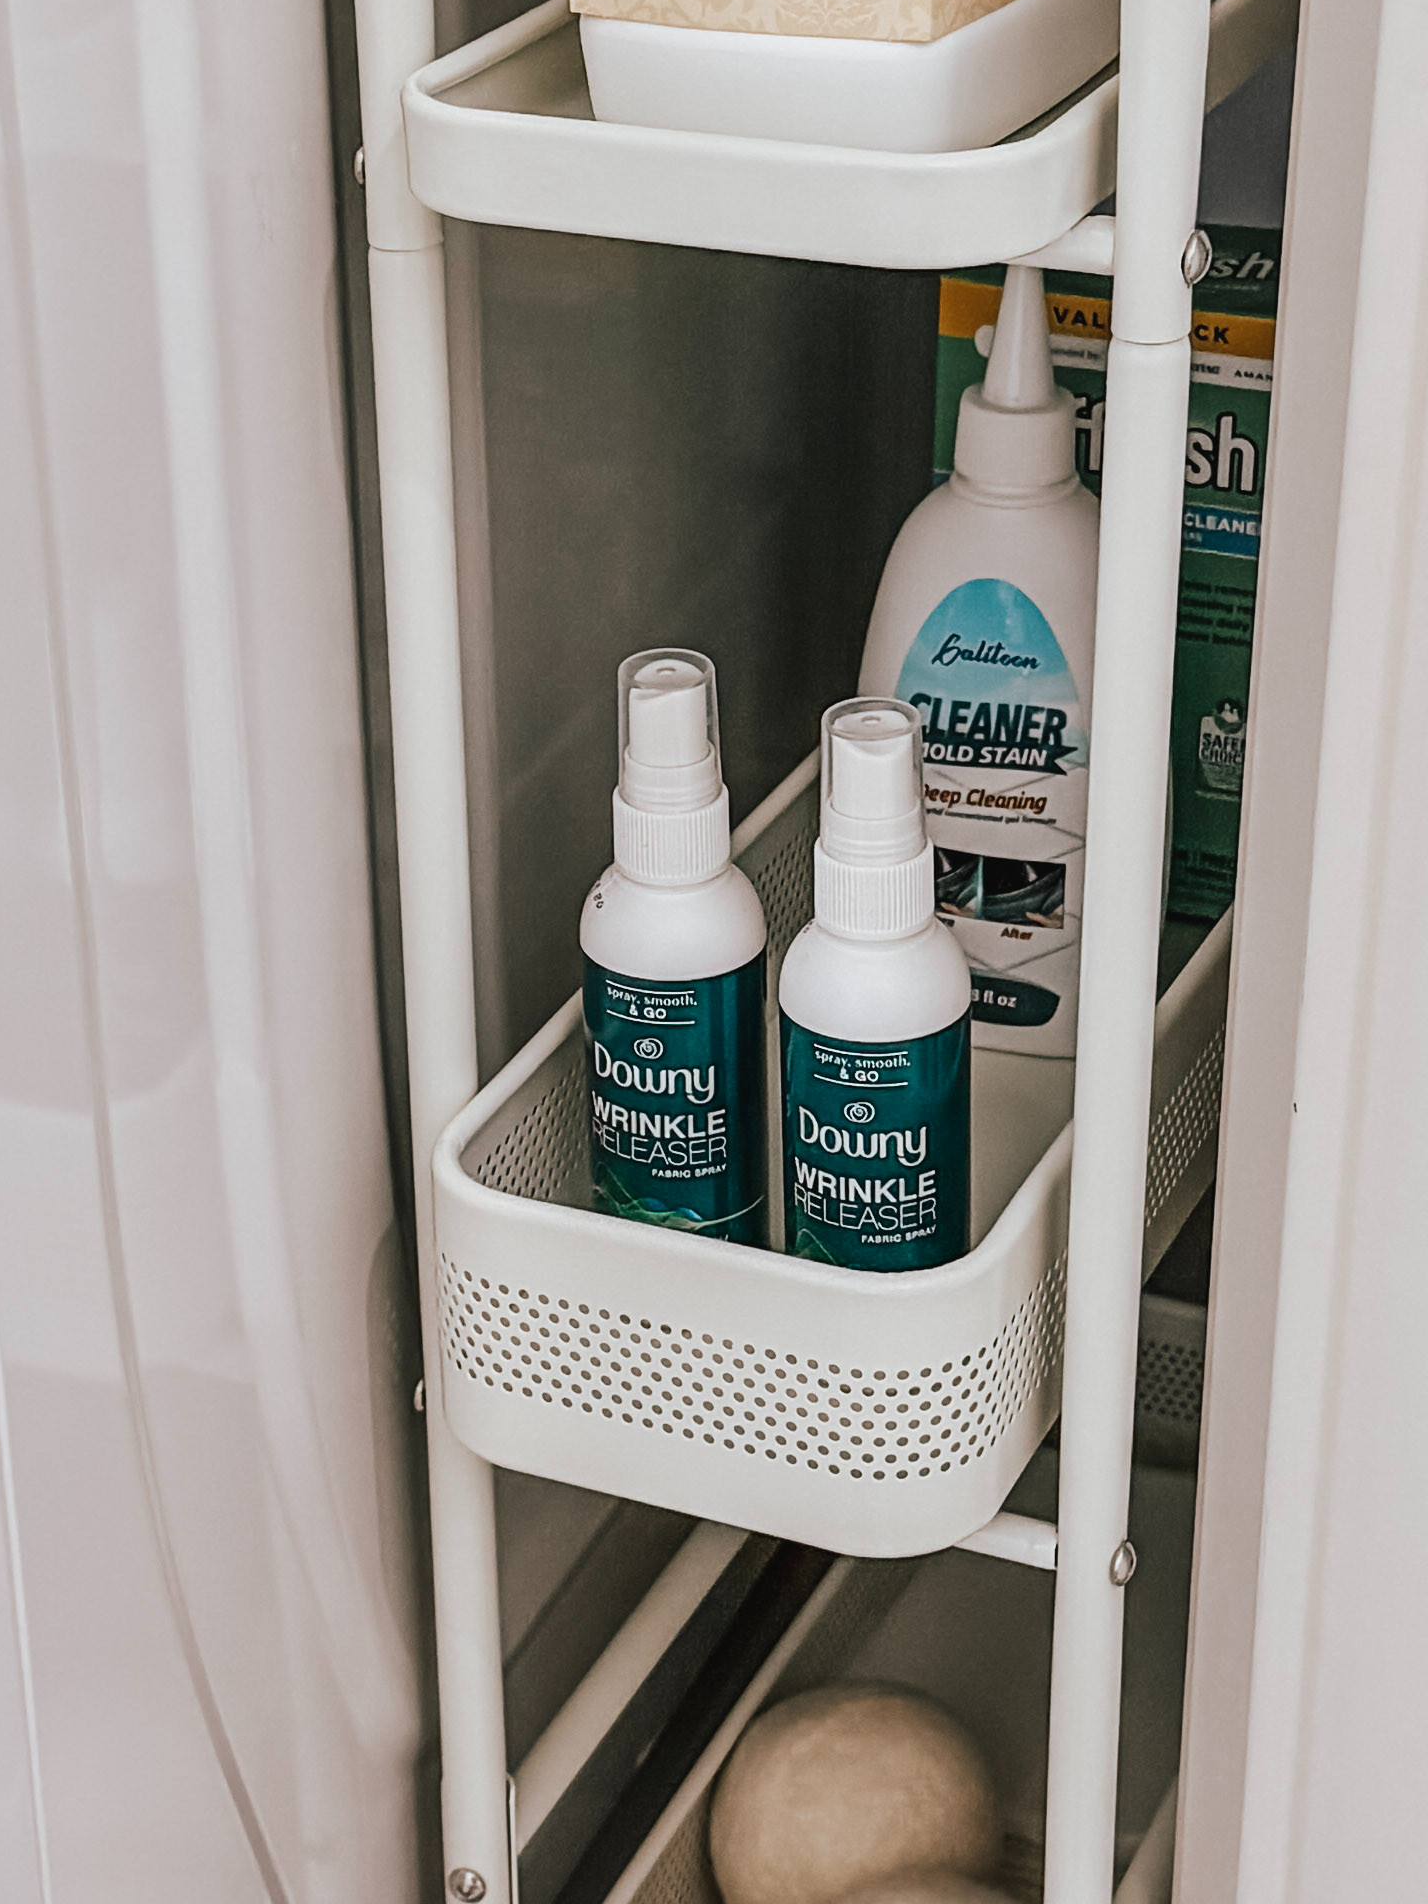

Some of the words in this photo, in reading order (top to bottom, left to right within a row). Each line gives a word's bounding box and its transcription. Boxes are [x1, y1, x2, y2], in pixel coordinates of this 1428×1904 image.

[1052, 305, 1106, 329] VAL
[1193, 324, 1230, 345] CK
[1184, 512, 1260, 536] CLEANE
[908, 691, 1068, 747] CLEANER
[978, 746, 1048, 767] STAIN
[924, 783, 962, 809] eep
[965, 788, 1048, 815] Cleaning
[606, 986, 641, 1006] spray.
[644, 992, 698, 1007] smooth.
[997, 995, 1017, 1008] oz
[643, 1007, 667, 1020] GO
[594, 1040, 716, 1105] Downy
[814, 1049, 852, 1069] spray.
[855, 1053, 911, 1069] smooth.
[854, 1070, 880, 1083] GO
[591, 1089, 726, 1139] WRINKLE
[592, 1115, 727, 1167] RELEASER
[798, 1105, 927, 1167] Downy
[651, 1168, 691, 1179] FABRIC
[794, 1156, 936, 1204] WRINKLE
[794, 1182, 937, 1231] RELEASER
[861, 1234, 902, 1244] FABRIC
[905, 1224, 937, 1243] SPRAY
